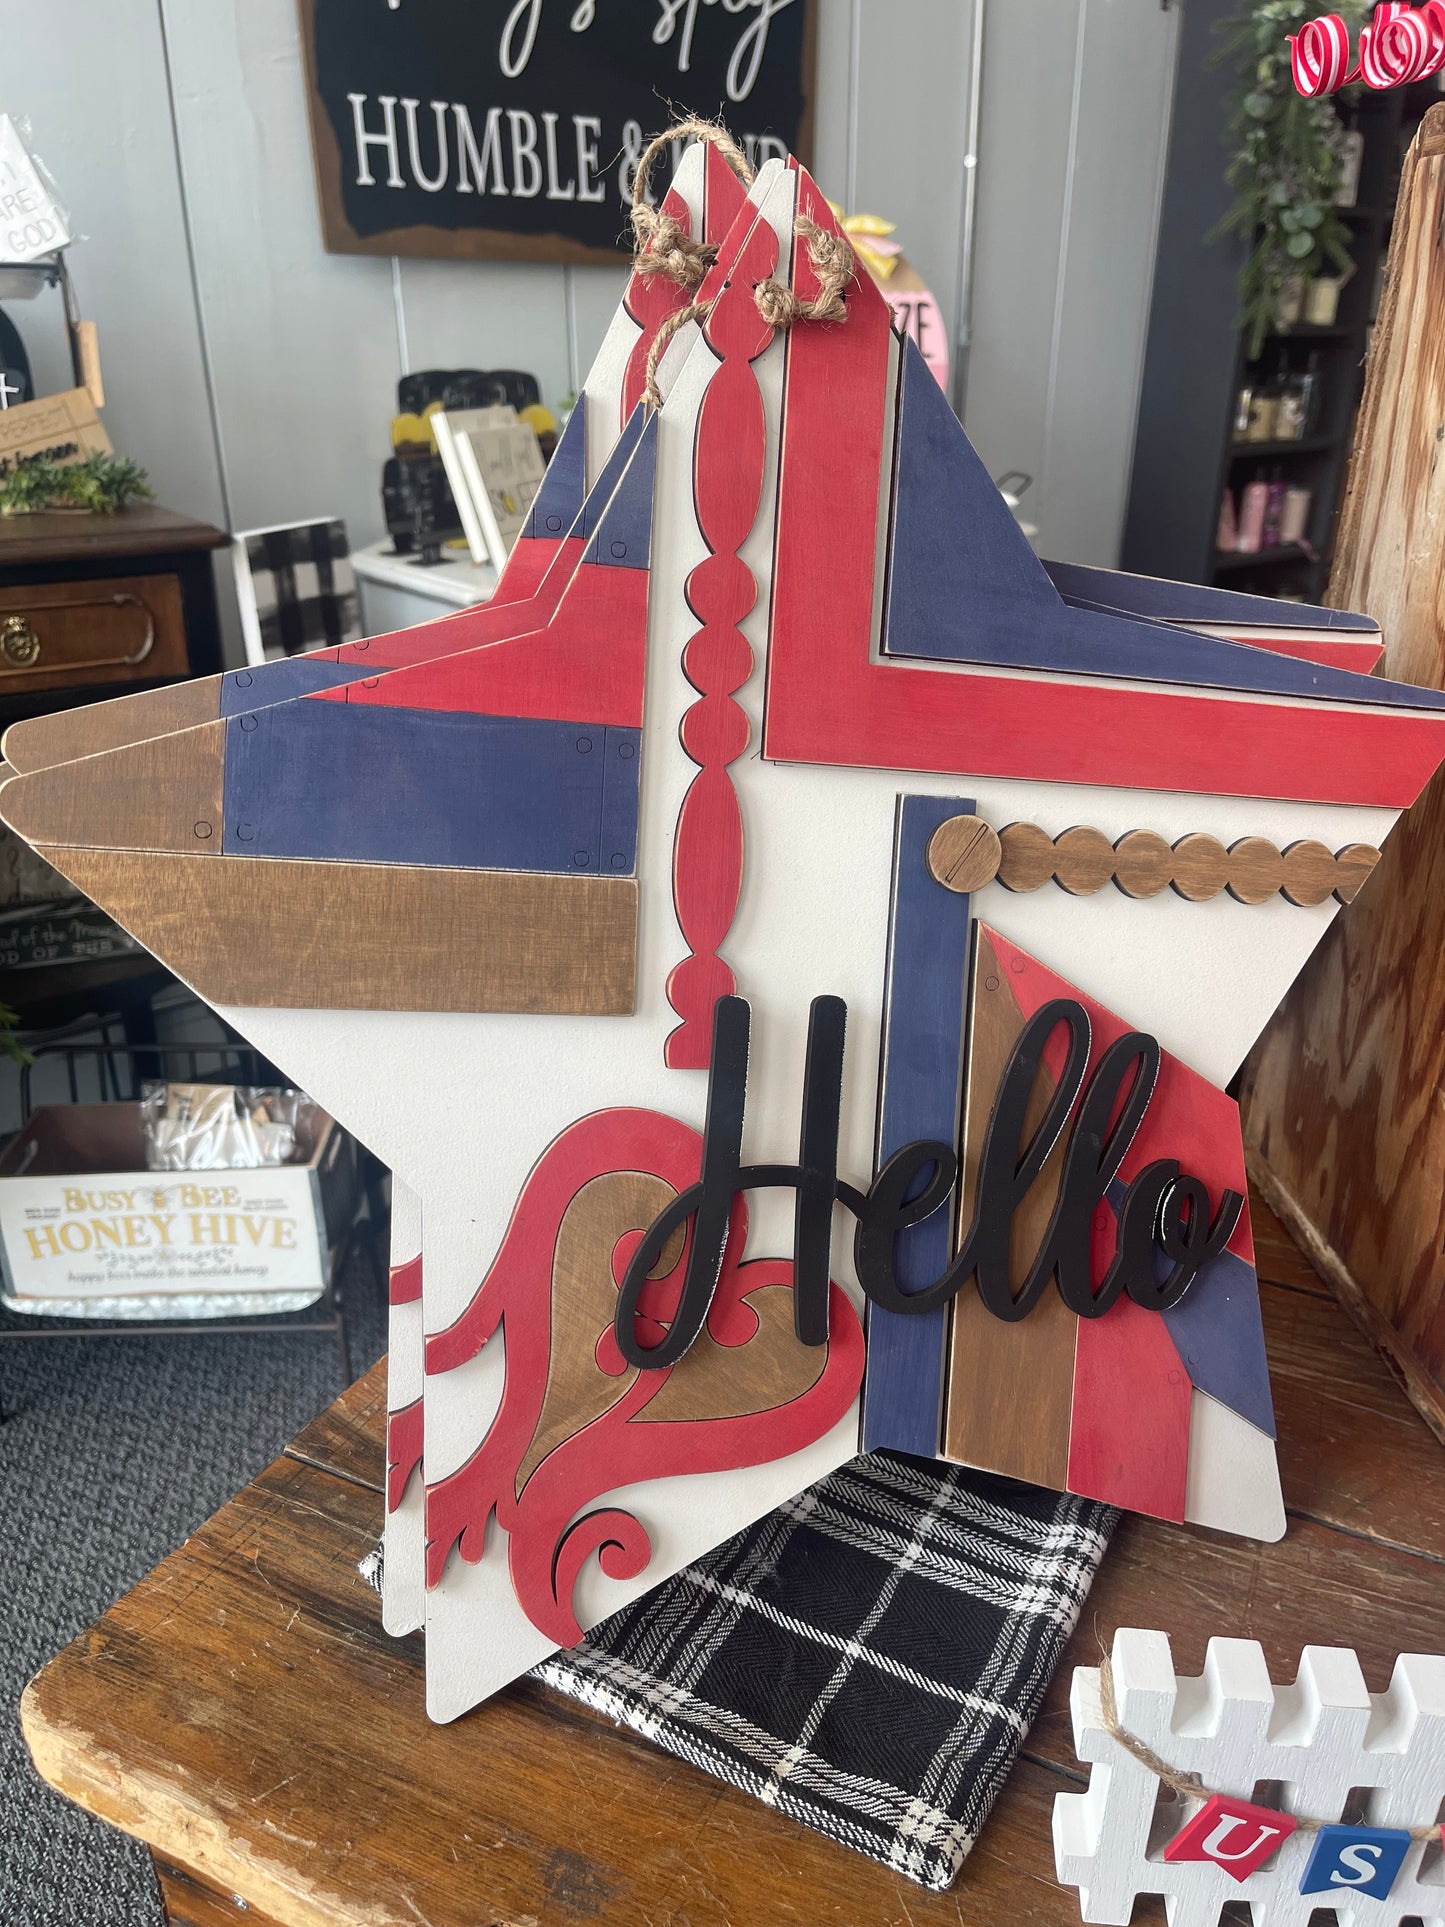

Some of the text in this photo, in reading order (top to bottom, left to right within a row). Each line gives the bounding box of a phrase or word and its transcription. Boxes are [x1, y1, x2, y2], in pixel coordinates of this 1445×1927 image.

[347, 93, 606, 203] HUMBLE
[618, 120, 659, 206] &
[7, 218, 57, 254] GOD
[181, 1182, 241, 1209] BEE
[614, 995, 1244, 1370] Hello
[23, 1213, 298, 1260] HONEY HIVE
